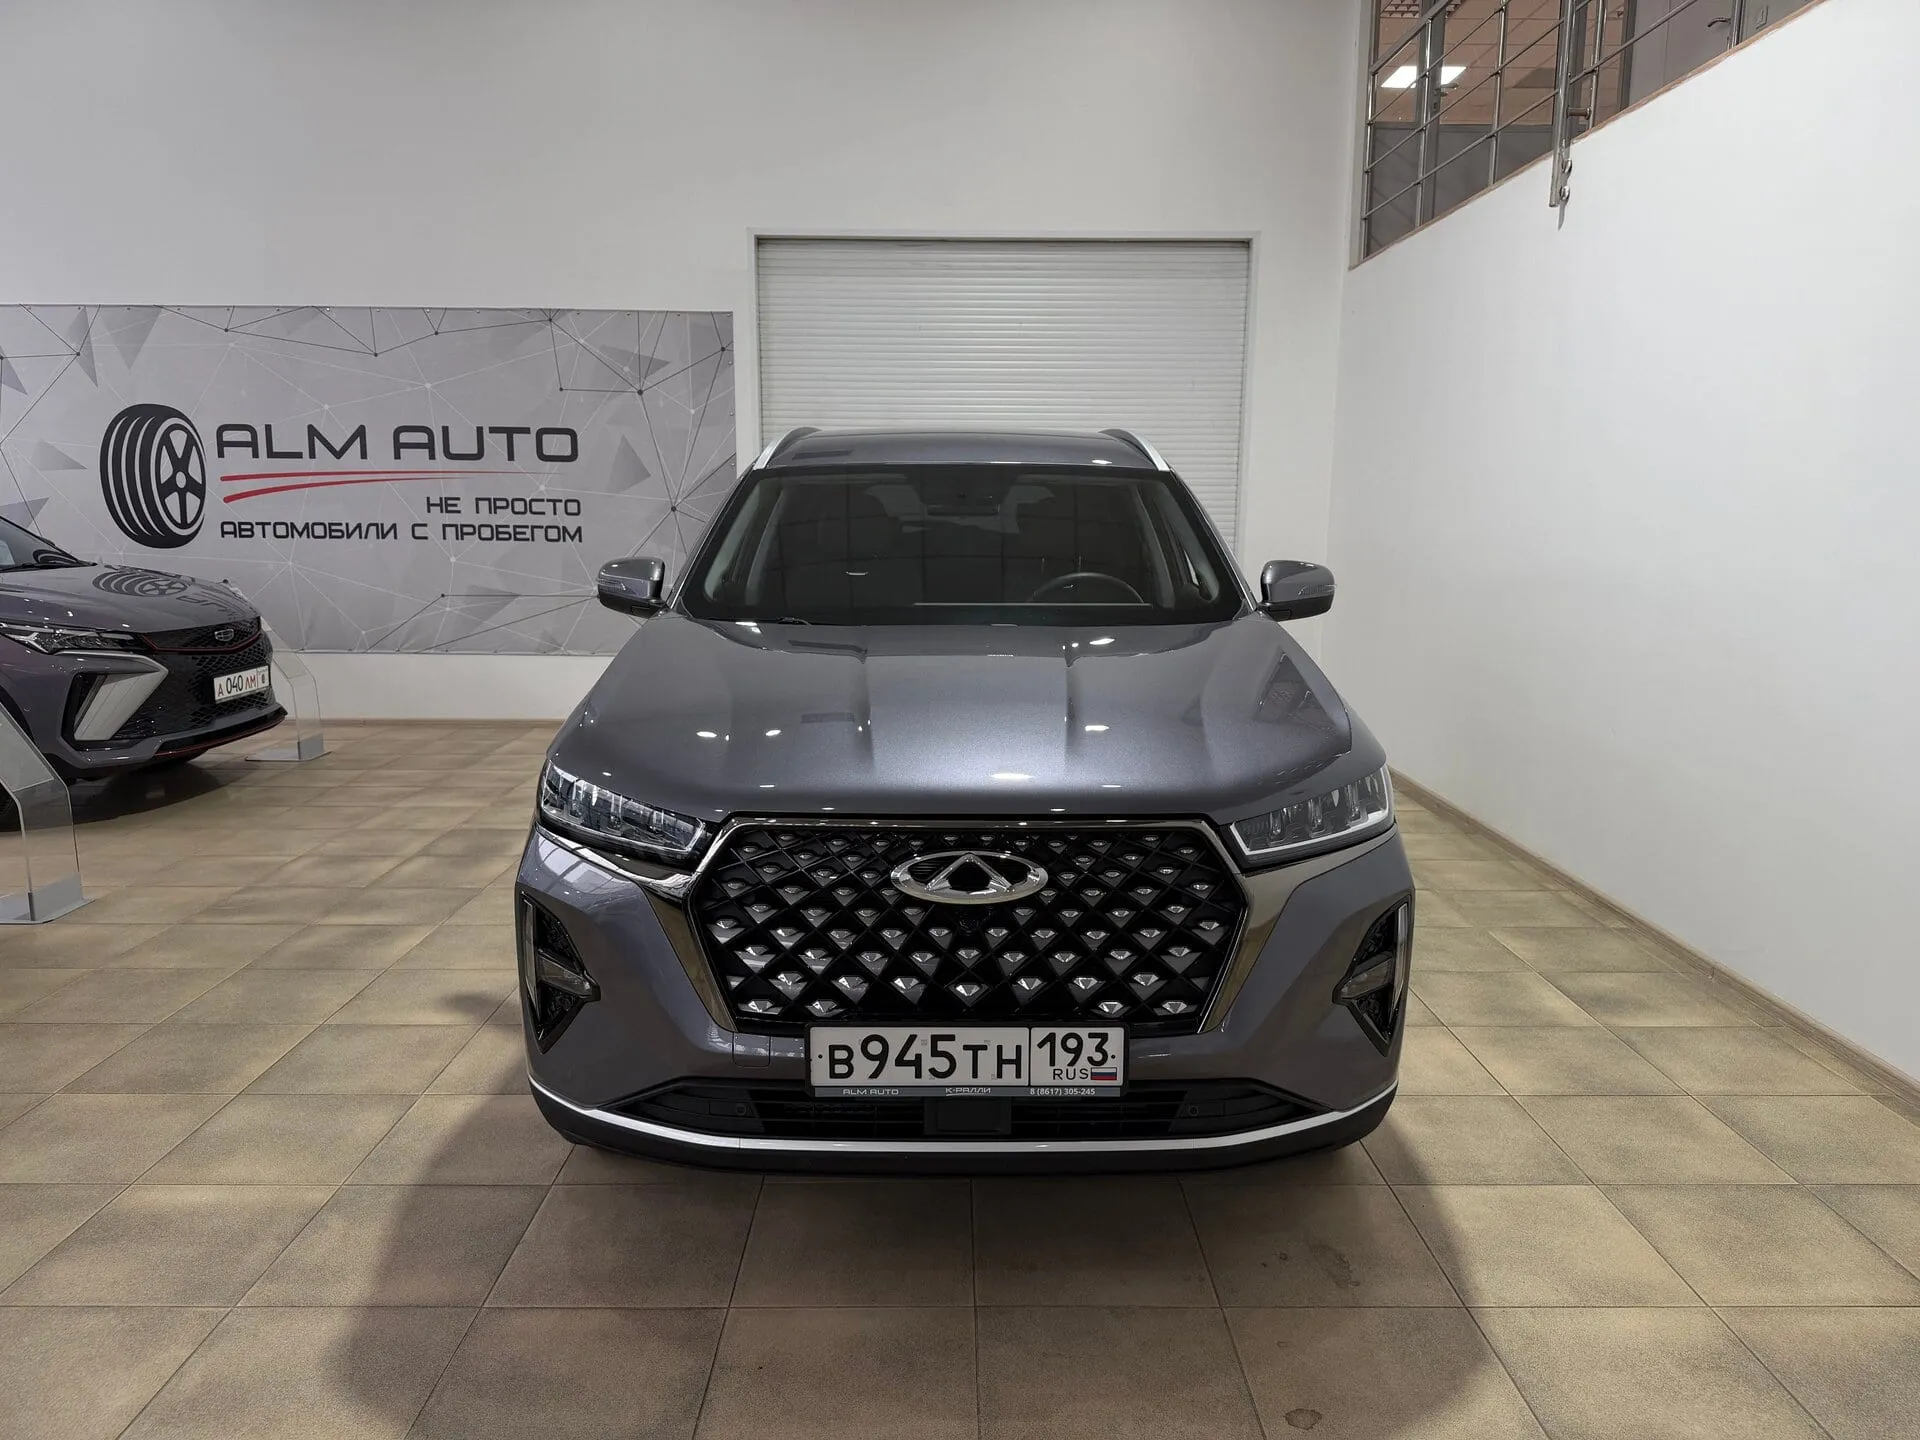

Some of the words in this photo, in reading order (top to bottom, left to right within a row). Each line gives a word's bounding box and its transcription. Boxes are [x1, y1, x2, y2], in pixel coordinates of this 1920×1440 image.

[217, 424, 368, 460] ALM
[393, 425, 579, 462] AUTO
[426, 497, 461, 515] НЕ
[475, 497, 581, 516] ПРОСТО
[220, 521, 397, 540] АВТОМОБИЛИ
[411, 522, 428, 540] С
[442, 523, 583, 543] ПРОБЕГОМ
[1037, 1032, 1109, 1067] 193
[1053, 1067, 1089, 1081] RUS
[1037, 1087, 1062, 1096] (8617)
